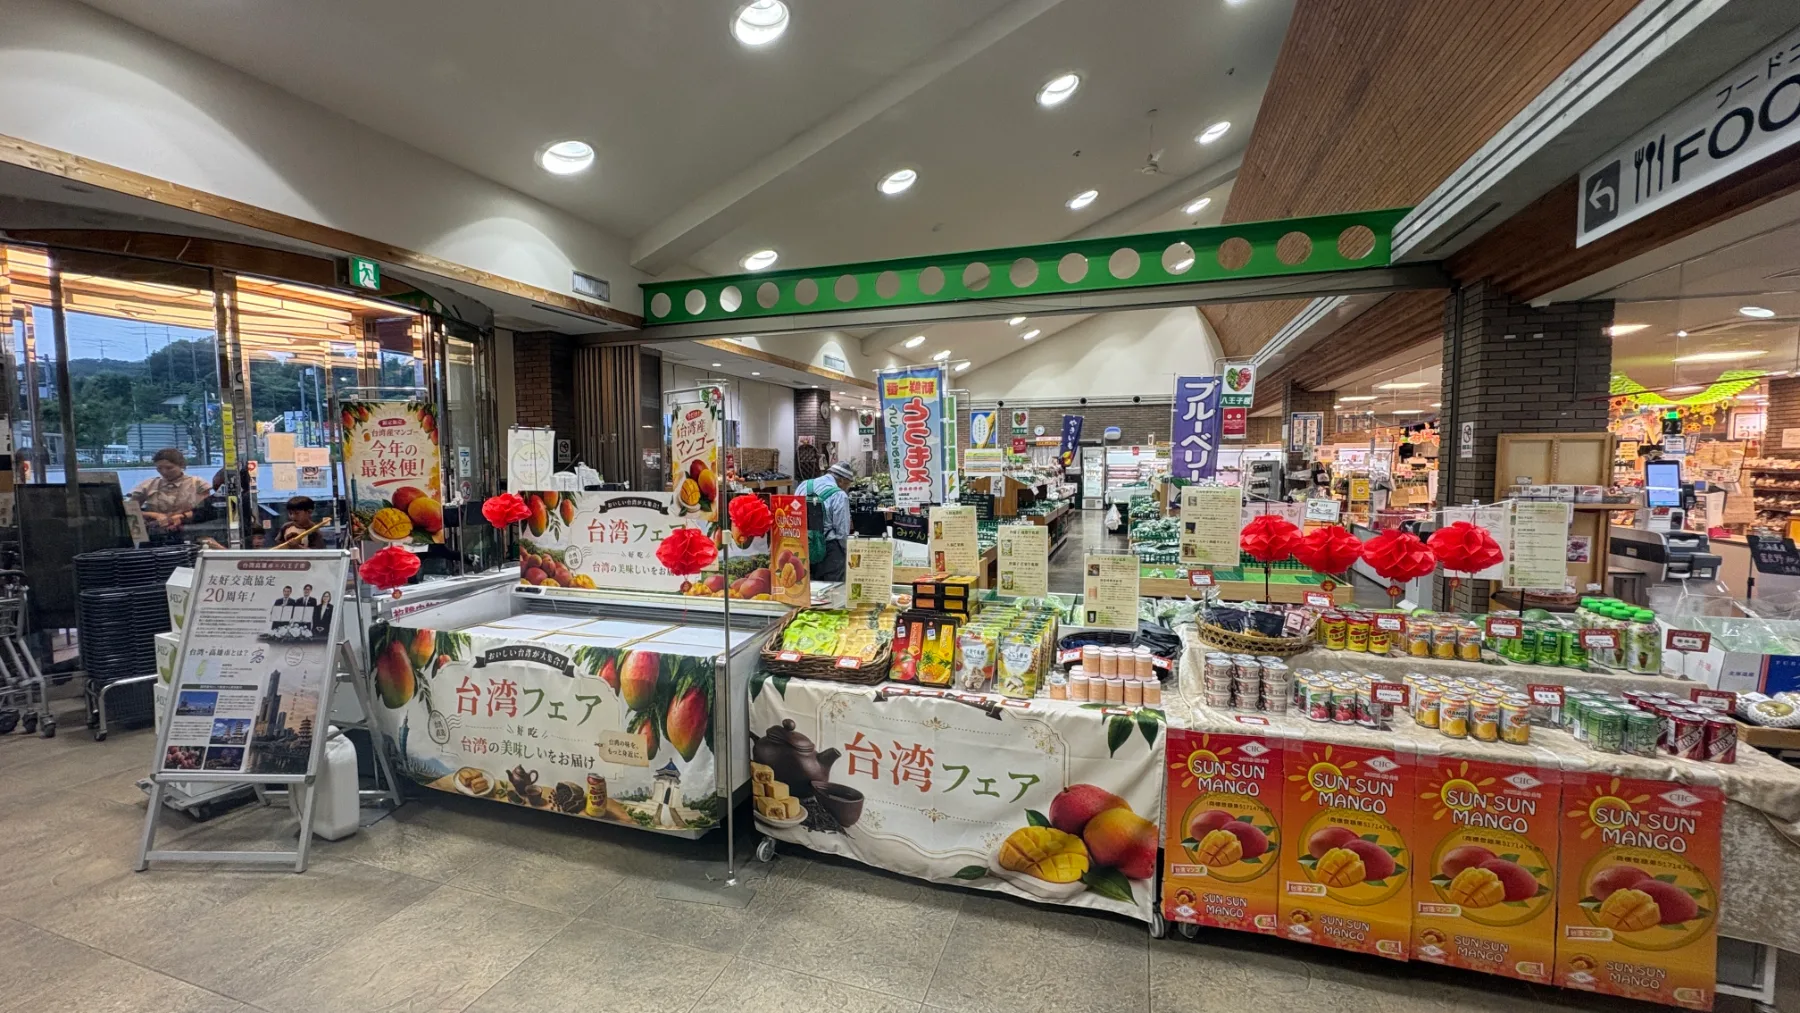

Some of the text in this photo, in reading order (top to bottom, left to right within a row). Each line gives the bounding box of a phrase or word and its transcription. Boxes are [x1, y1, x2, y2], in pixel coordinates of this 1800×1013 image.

[680, 419, 706, 439] 台湾産
[1067, 419, 1078, 450] やきいも
[1180, 380, 1220, 482] ブルーベリー
[370, 439, 418, 458] 今年の
[676, 433, 715, 456] マンゴー
[360, 458, 425, 478] 最終便!
[587, 518, 686, 545] 台湾フェ
[778, 527, 801, 538] MANGO
[896, 527, 926, 540] みかん
[592, 561, 674, 577] 台湾の美味しいをお届
[208, 575, 276, 586] 友好交流協定
[203, 588, 256, 603] 20周年!
[189, 647, 249, 657] 台湾・高雄市とは?
[487, 648, 565, 669] おいしい台湾が大集合!
[455, 676, 603, 726] 台湾フェア
[516, 725, 539, 738] 好吃
[460, 735, 596, 770] 台湾の美味しいをお届け
[844, 731, 1040, 804] 台湾フェア
[1192, 759, 1226, 776] SUN
[1230, 763, 1266, 780] SUN
[1198, 777, 1260, 797] MANGO
[1313, 772, 1350, 791] SUN
[1355, 778, 1394, 798] SUN
[1318, 791, 1387, 815] MANGO
[1446, 790, 1487, 809] SUN
[1493, 795, 1536, 816] SUN
[1452, 809, 1528, 833] MANGO
[1595, 807, 1640, 827] SUN
[1647, 812, 1696, 835] SUN
[1602, 827, 1687, 853] MANGO
[1203, 892, 1248, 907] SUN SUN
[1206, 904, 1244, 918] MANGO
[1320, 915, 1370, 932] SUN SUN
[1323, 925, 1365, 941] MANGO
[1454, 935, 1509, 953] SUN SUN
[1457, 946, 1504, 963] MANGO
[1606, 961, 1667, 979] SUN SUN
[1609, 972, 1660, 990] MANGO
